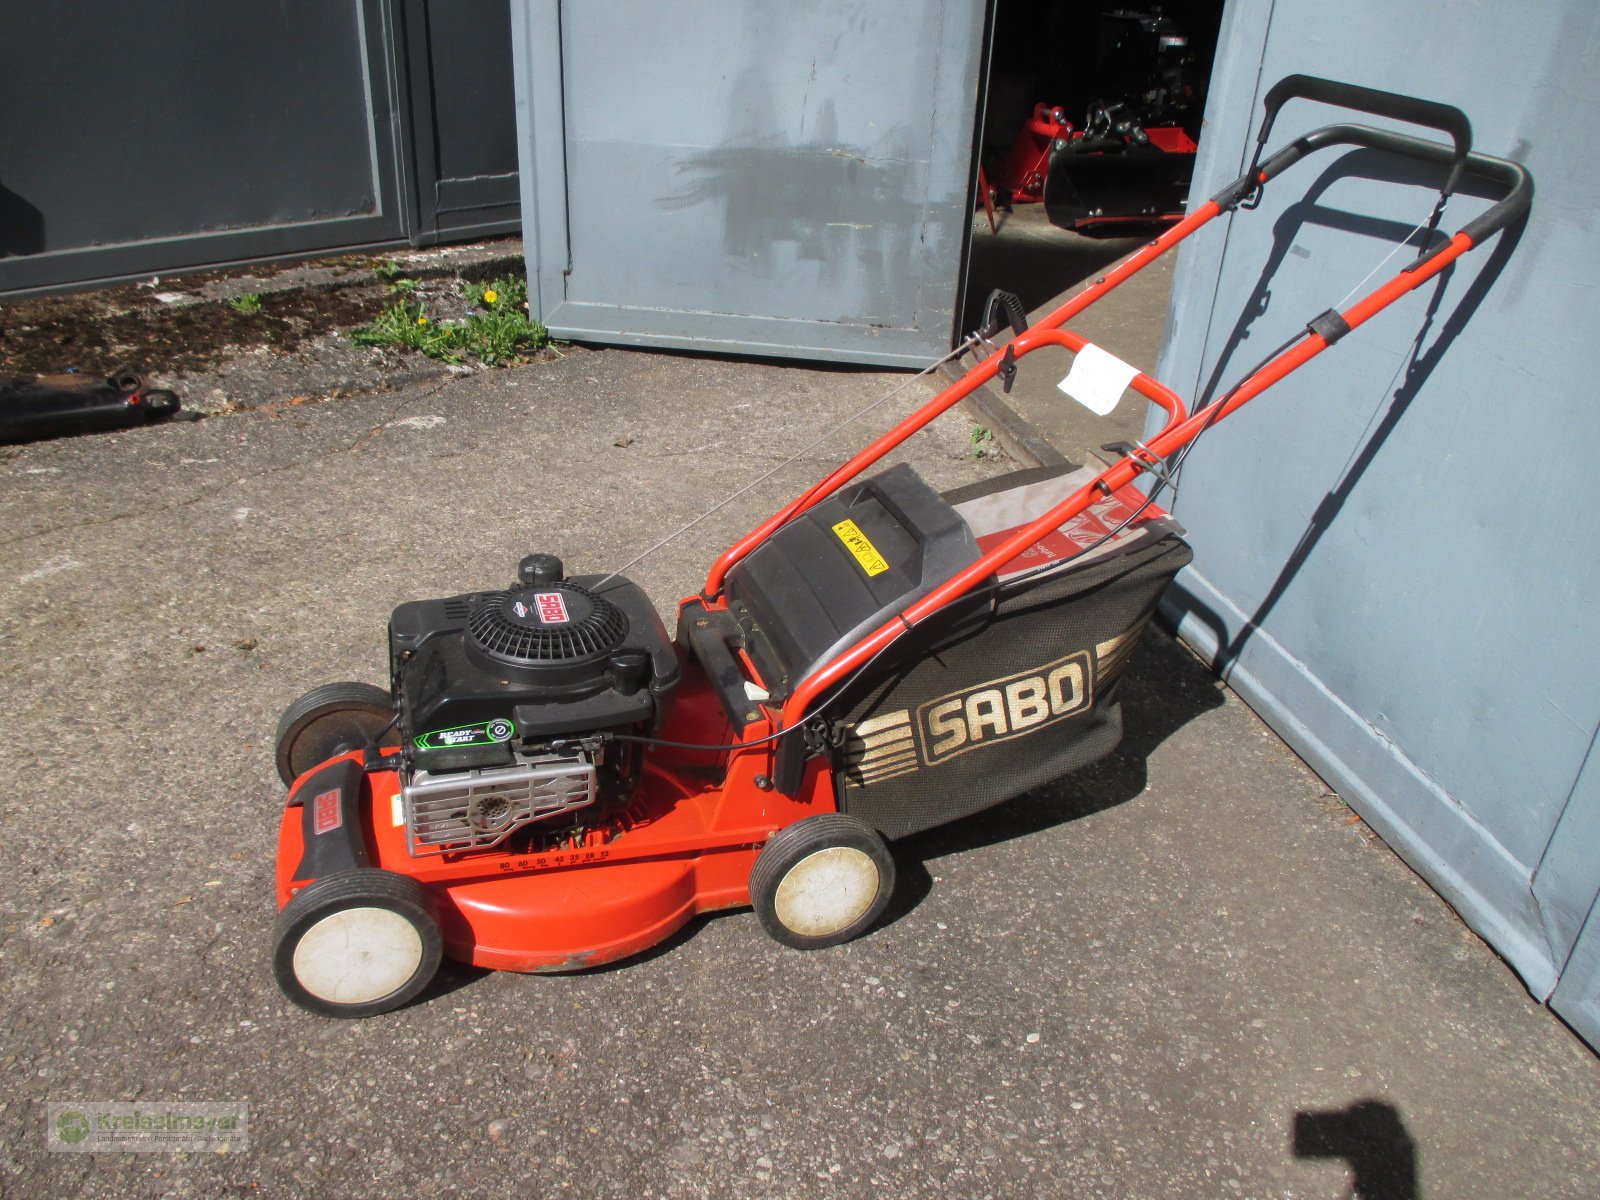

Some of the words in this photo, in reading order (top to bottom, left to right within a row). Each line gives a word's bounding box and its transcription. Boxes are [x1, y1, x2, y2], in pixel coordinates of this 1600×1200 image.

[538, 595, 565, 622] SABO
[928, 662, 1084, 756] SABO
[438, 729, 473, 740] READY
[316, 790, 339, 830] SABO
